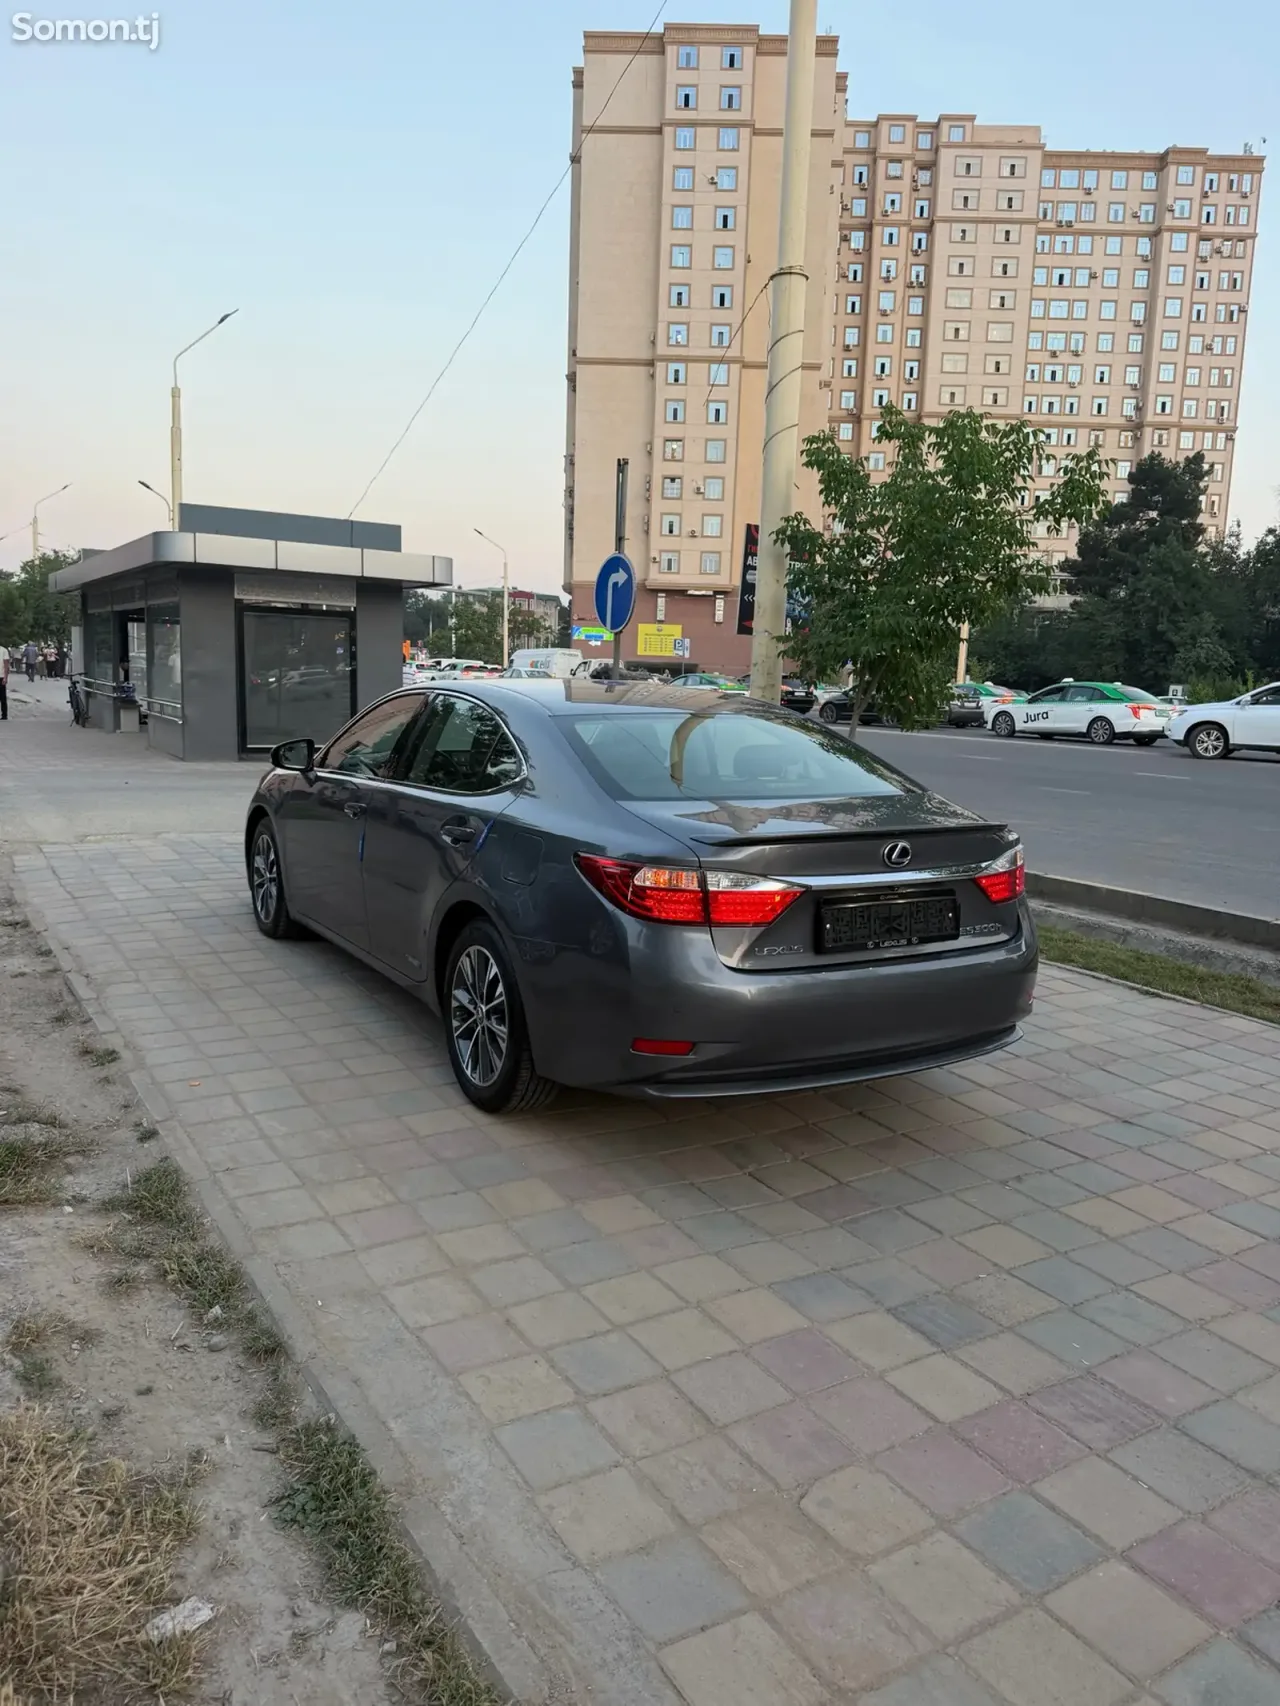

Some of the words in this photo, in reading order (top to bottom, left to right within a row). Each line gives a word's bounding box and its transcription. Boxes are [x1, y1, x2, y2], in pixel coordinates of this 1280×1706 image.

[1023, 711, 1048, 723] Jura
[879, 939, 908, 948] LEXUS
[754, 944, 804, 956] LEXUS
